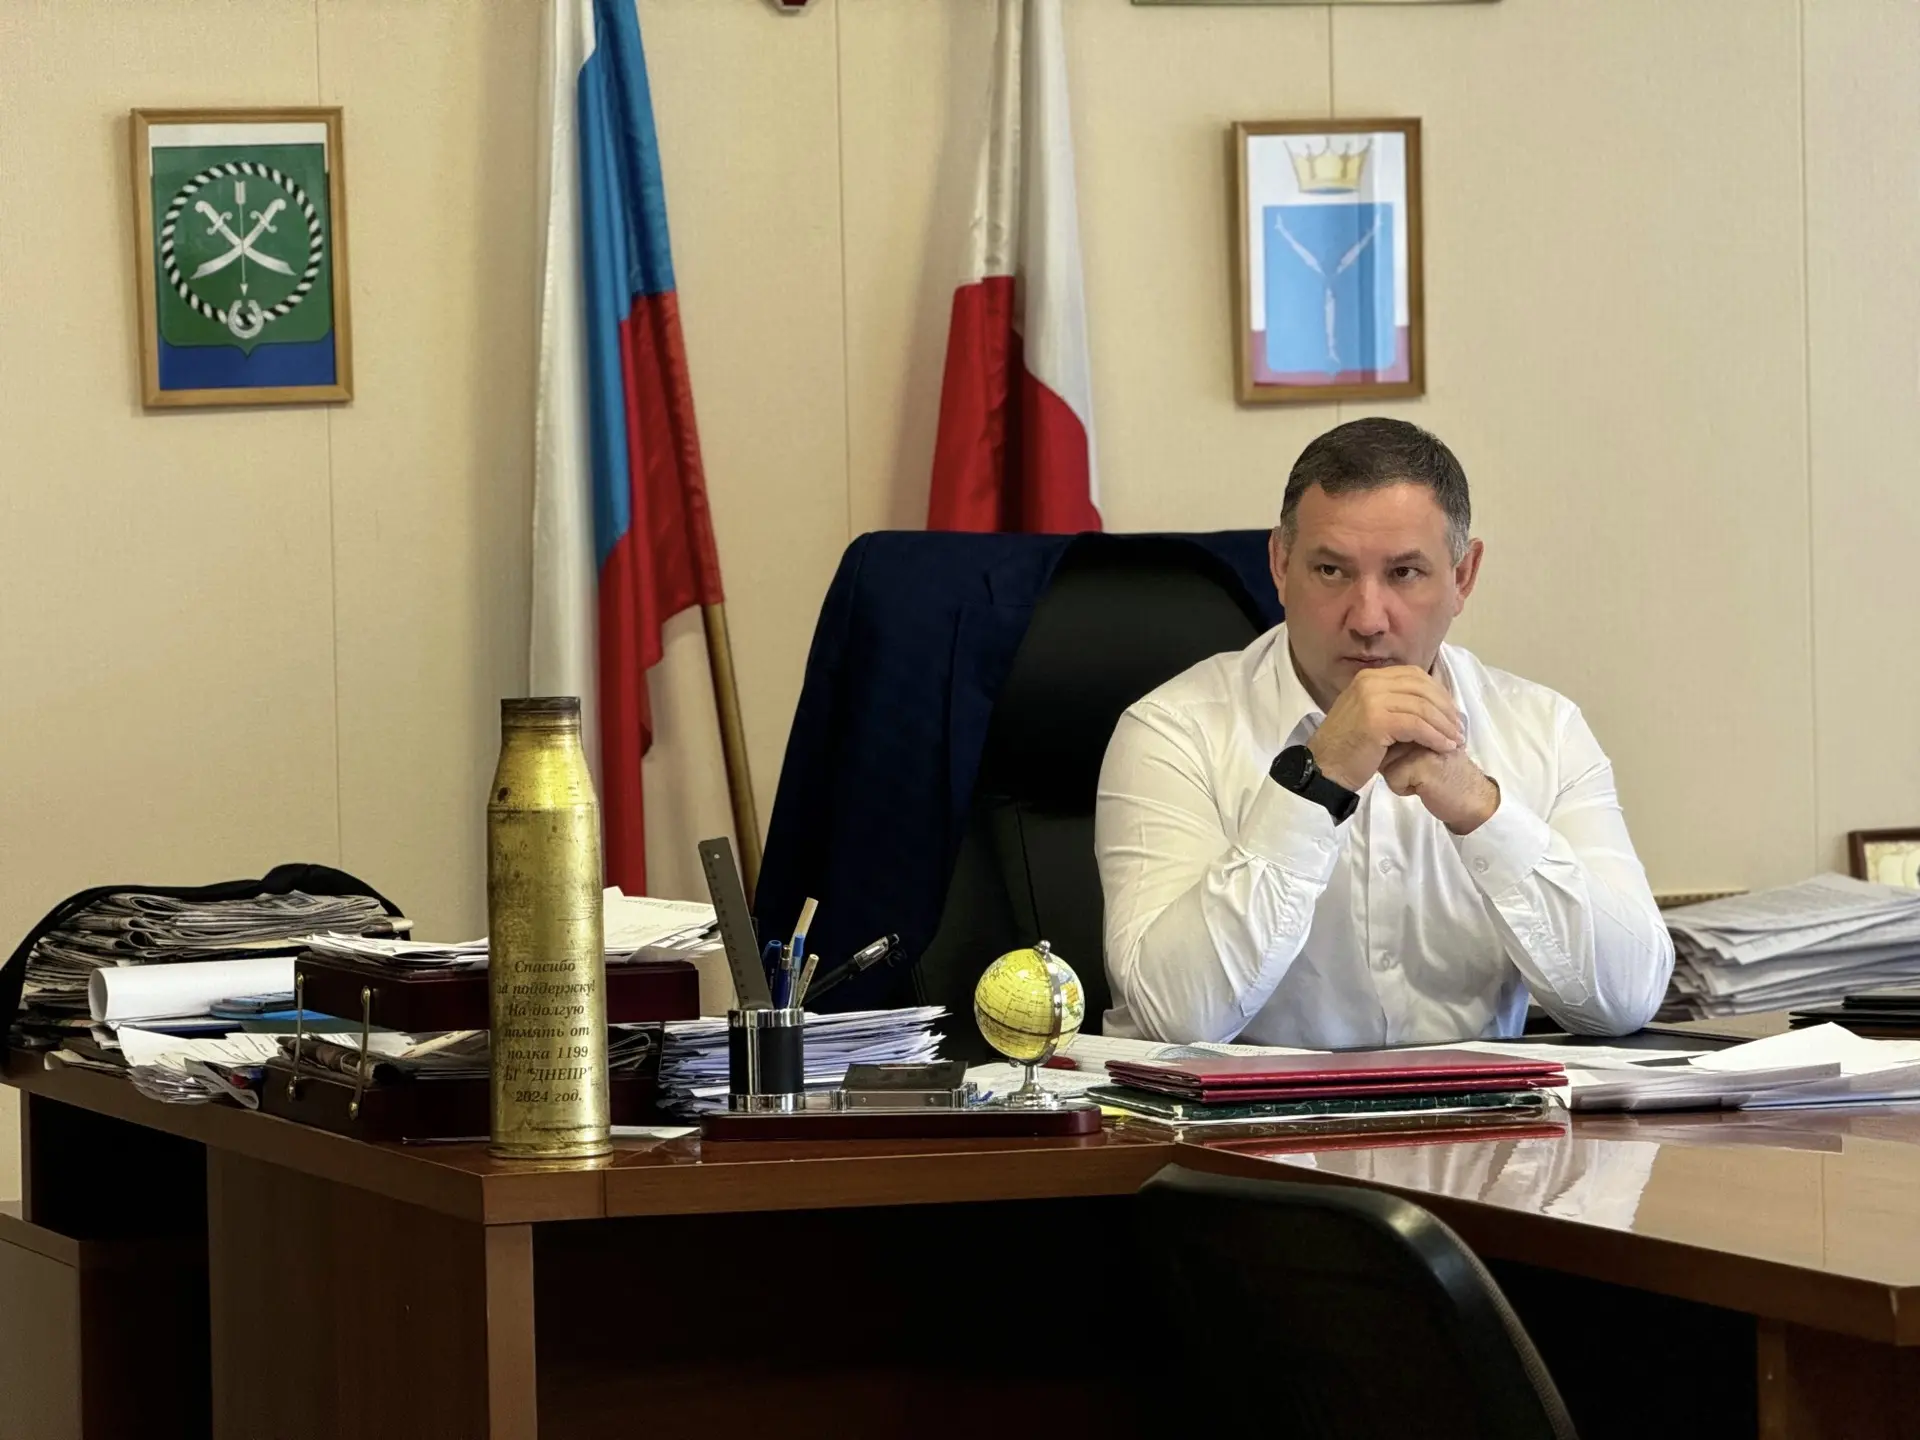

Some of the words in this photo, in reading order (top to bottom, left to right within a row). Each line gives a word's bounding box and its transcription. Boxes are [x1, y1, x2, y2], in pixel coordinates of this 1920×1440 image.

[514, 959, 576, 973] Спасибо
[508, 1003, 526, 1016] На
[531, 1003, 585, 1019] долгую
[504, 1026, 565, 1038] память
[570, 1026, 590, 1037] от
[507, 1049, 551, 1060] полка
[557, 1046, 589, 1059] 1199
[515, 1090, 549, 1103] 2024
[554, 1088, 582, 1103] год.
